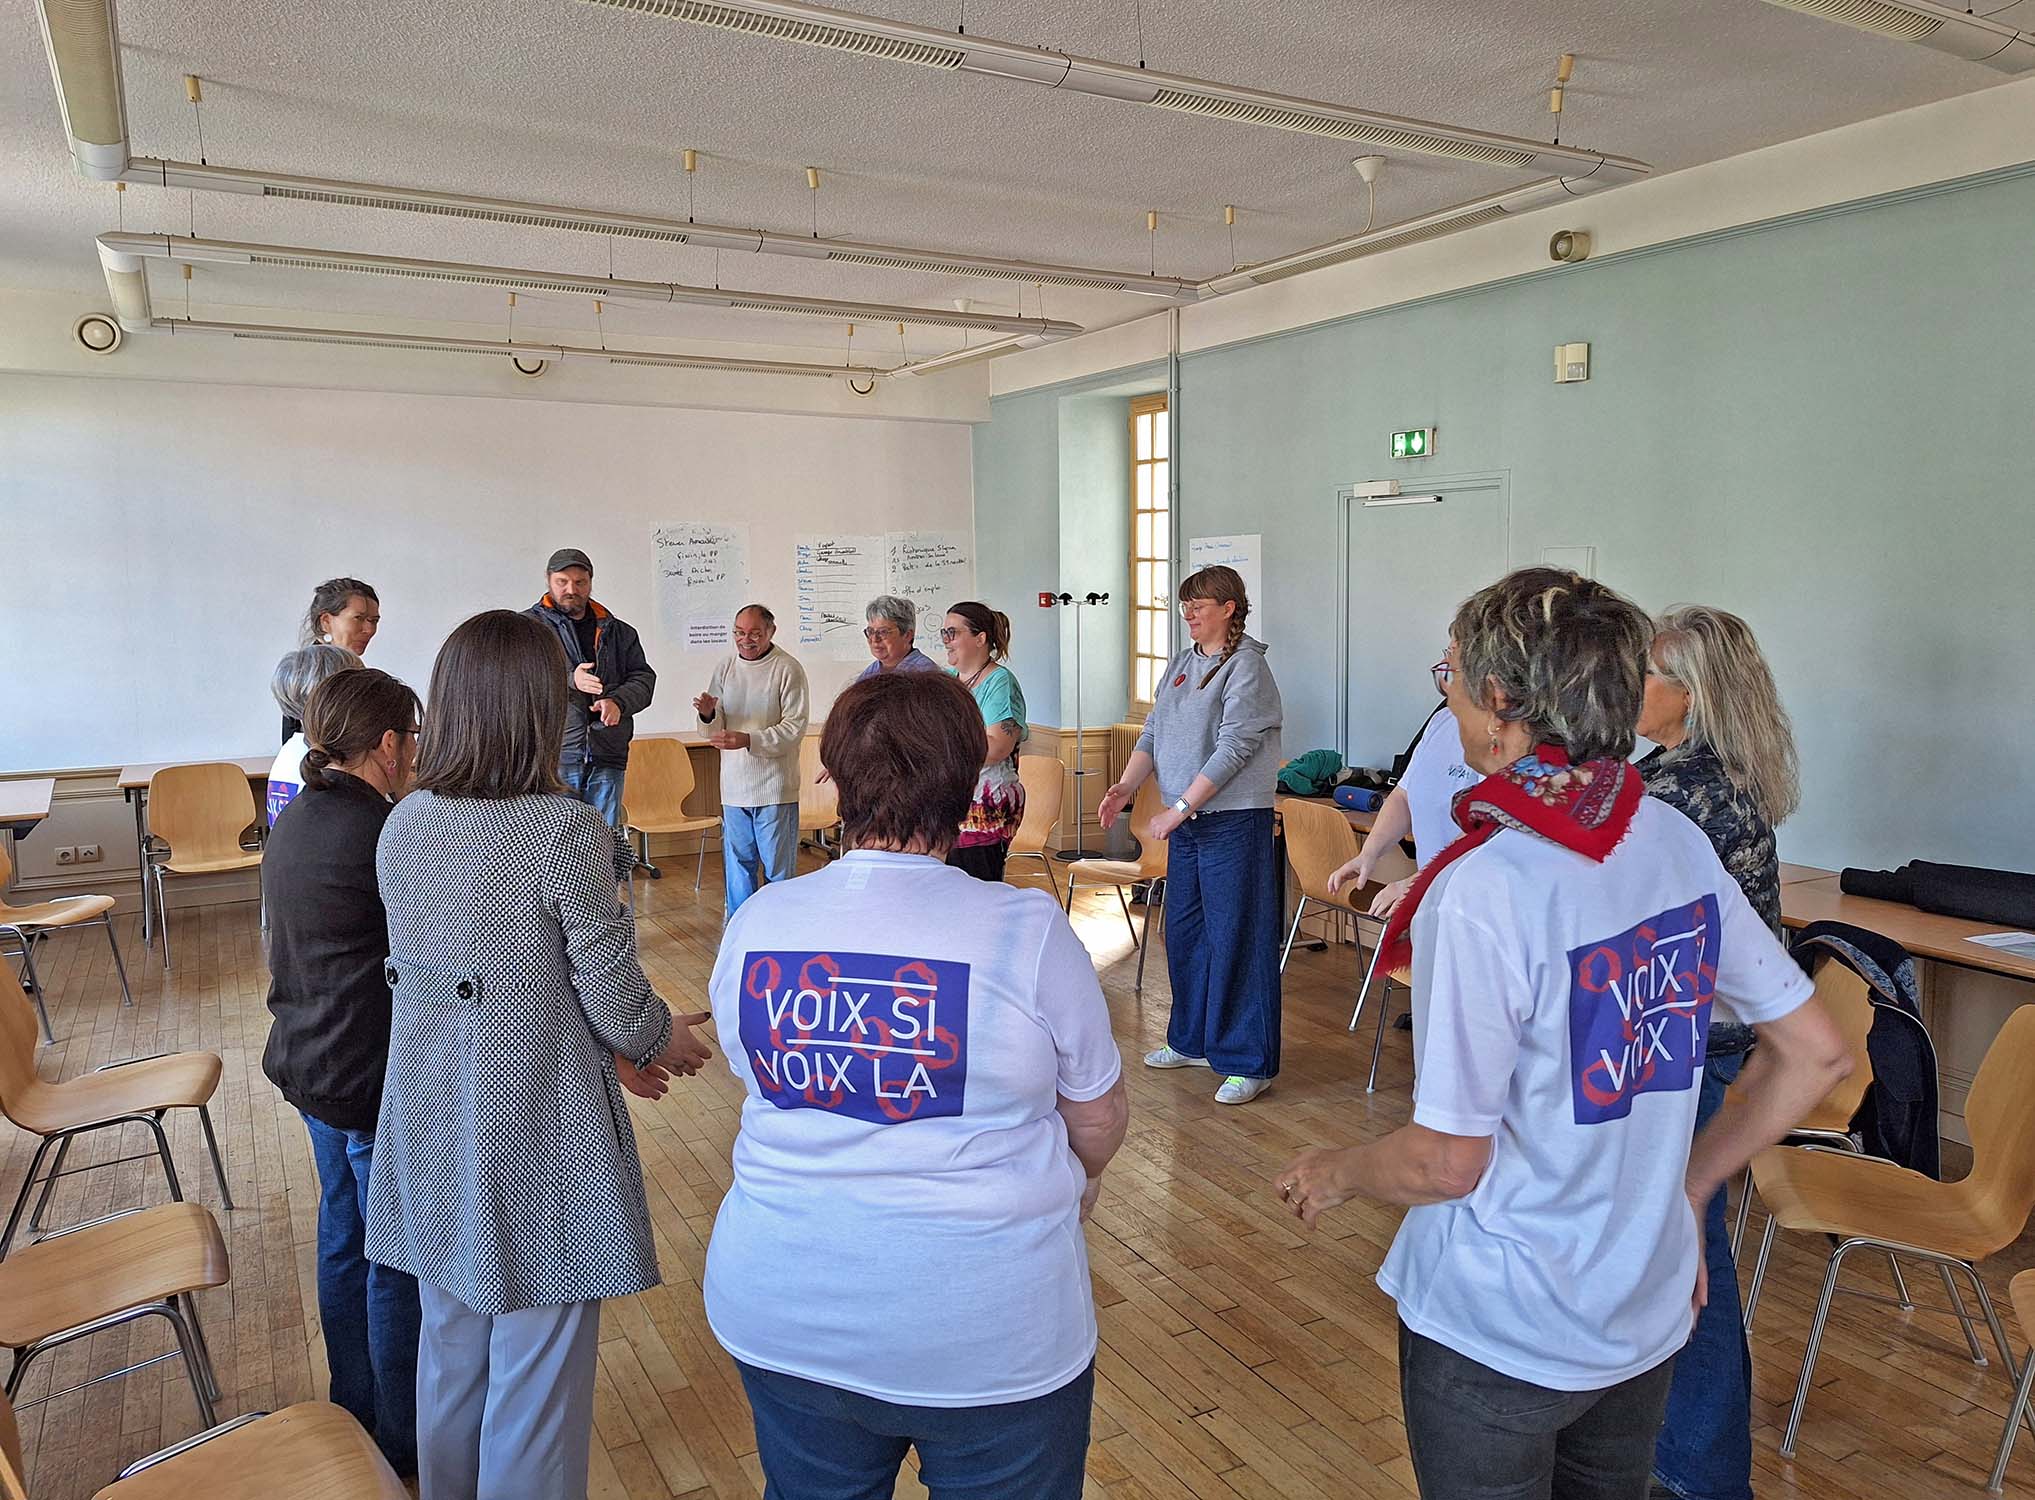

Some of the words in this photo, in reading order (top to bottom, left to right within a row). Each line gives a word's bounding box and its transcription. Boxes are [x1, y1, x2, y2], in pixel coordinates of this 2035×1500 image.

[1608, 948, 1683, 1022] VOIX
[765, 988, 870, 1035] VOIX
[889, 995, 936, 1042] SI
[755, 1048, 857, 1094] VOIX
[873, 1057, 938, 1100] LA
